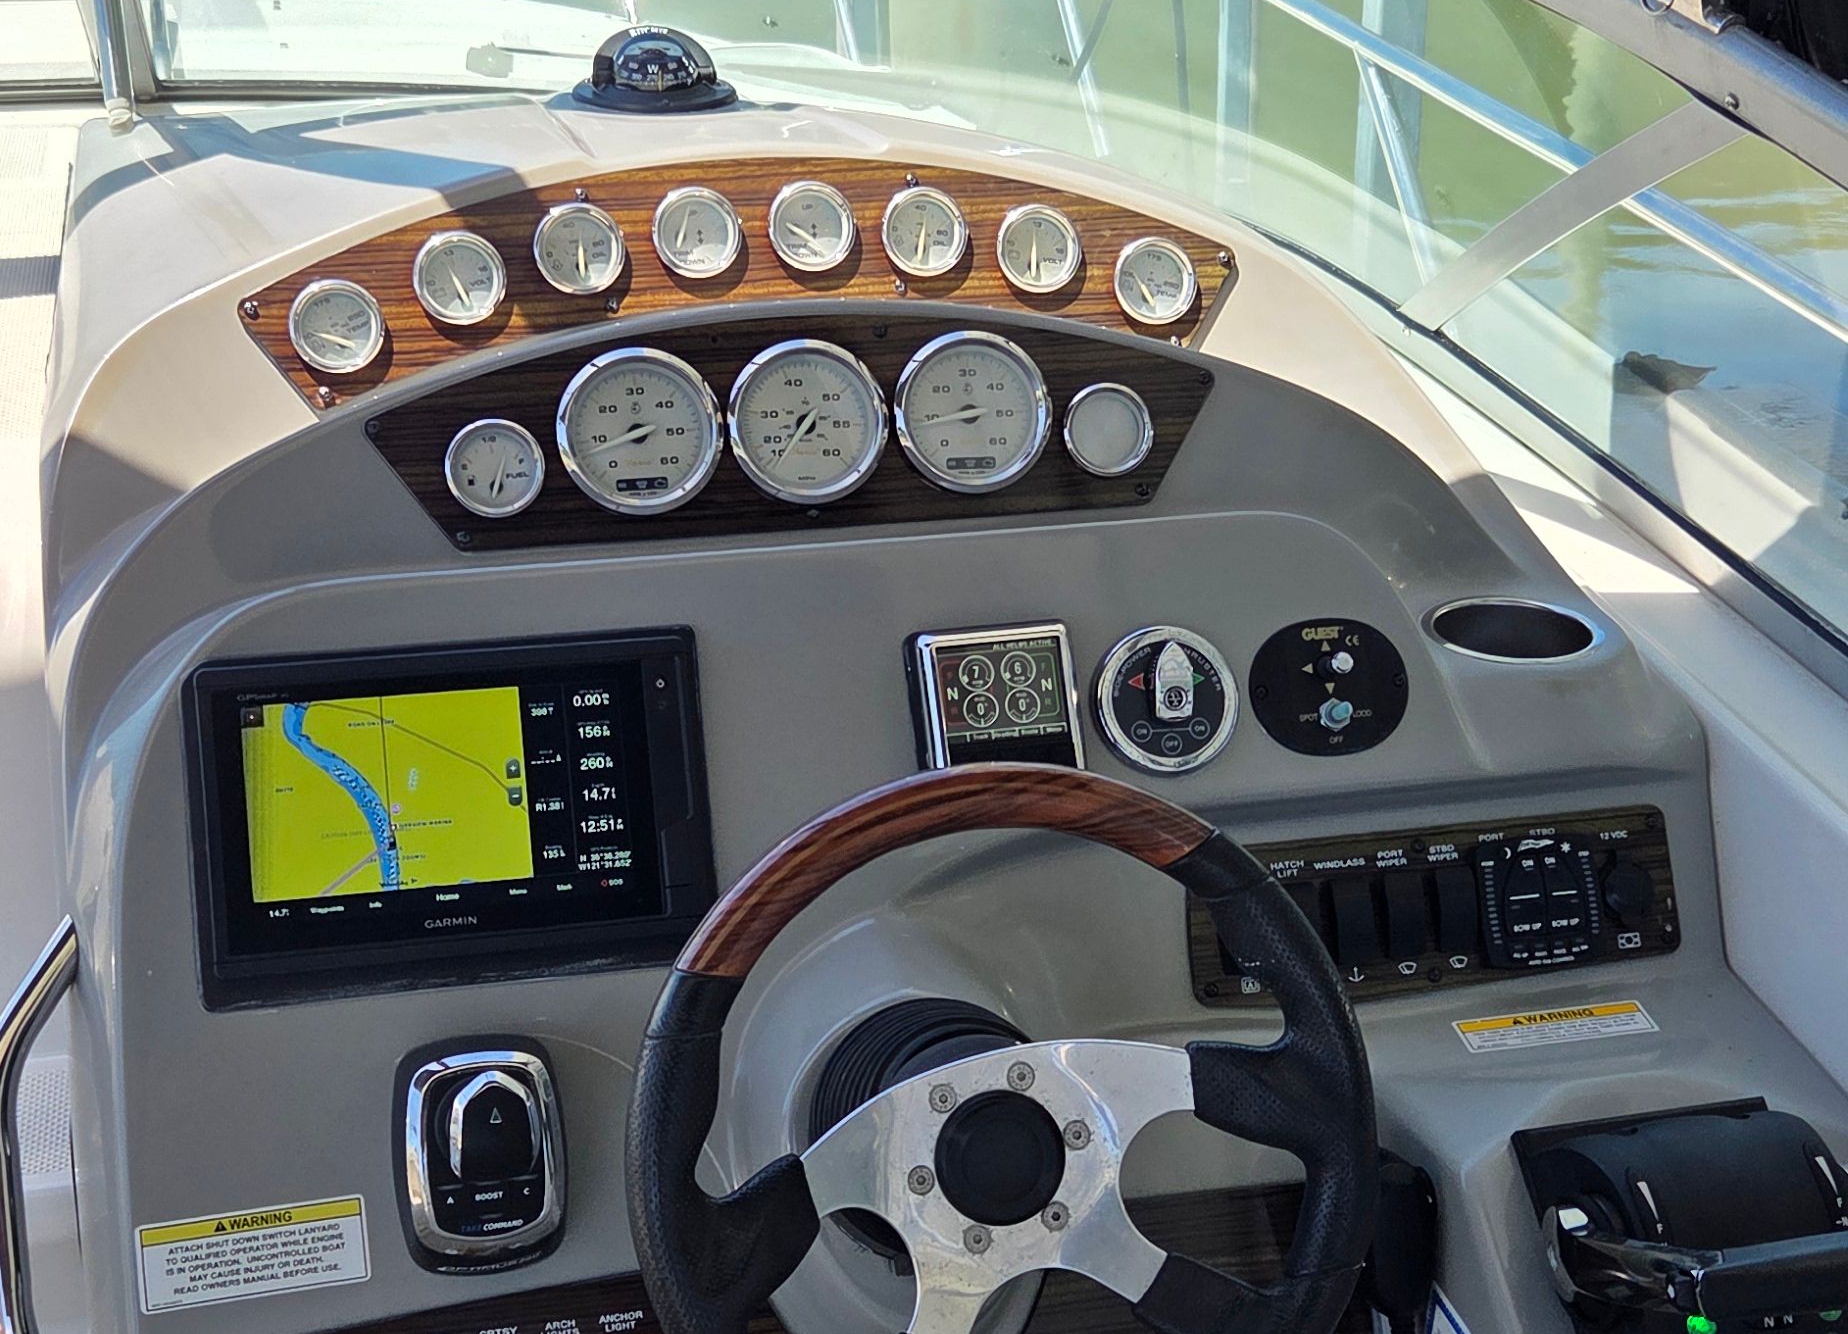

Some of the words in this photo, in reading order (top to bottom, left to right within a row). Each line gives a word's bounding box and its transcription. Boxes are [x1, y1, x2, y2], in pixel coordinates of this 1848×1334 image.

[1041, 256, 1064, 266] VOLT
[469, 276, 491, 288] VOLT
[347, 321, 371, 334] TEMP
[958, 368, 977, 377] 30
[784, 378, 803, 388] 40
[986, 382, 1005, 391] 40
[625, 387, 645, 396] 30
[932, 385, 951, 394] 20
[822, 393, 841, 402] 50
[598, 404, 618, 414] 20
[655, 400, 674, 409] 40
[760, 410, 779, 419] 30
[996, 409, 1014, 418] 50
[832, 420, 851, 429] 55
[666, 427, 685, 436] 50
[591, 434, 608, 443] 10
[763, 435, 782, 444] 20
[940, 439, 949, 447] 0
[989, 437, 1007, 446] 60
[822, 448, 841, 457] 60
[608, 460, 618, 469] 0
[660, 456, 679, 465] 60
[506, 471, 529, 479] FUEL
[1301, 626, 1340, 641] GUEST
[972, 666, 979, 678] 7
[1014, 662, 1022, 673] 6
[1041, 678, 1053, 692] N
[947, 687, 959, 701] N
[573, 694, 601, 707] 0.00
[578, 726, 601, 739] 156
[1193, 725, 1206, 733] ON
[1165, 740, 1178, 748] OFF
[1329, 736, 1344, 744] OFF
[580, 757, 605, 770] 260
[582, 788, 610, 801] 14.7
[580, 819, 614, 833] 12:51
[1478, 833, 1504, 842] PORT
[1611, 830, 1628, 839] VDC
[1377, 849, 1403, 859] PORT
[1429, 844, 1454, 854] STBD
[1376, 857, 1407, 867] WIPER
[1427, 852, 1458, 862] WIPER
[1270, 860, 1304, 871] HATCH
[1314, 857, 1366, 870] WINDLASS
[1277, 869, 1298, 879] LIFT
[424, 916, 477, 928] GARMIN
[1524, 1008, 1594, 1024] WARNING
[447, 1196, 454, 1204] A
[475, 1191, 503, 1201] BOOST
[523, 1187, 530, 1195] C
[229, 1211, 292, 1230] WARNING
[483, 1219, 523, 1231] COMMAND
[1656, 1223, 1664, 1235] F
[168, 1243, 203, 1255] ATTACH
[206, 1239, 229, 1249] SHUT
[232, 1235, 260, 1245] DOWN
[262, 1230, 296, 1241] SWITCH
[299, 1223, 340, 1235] LANYARD
[166, 1258, 178, 1266] TO
[180, 1250, 227, 1264] QUALIFIED
[230, 1242, 278, 1255] OPERATOR
[281, 1238, 308, 1248] WHILE
[311, 1233, 344, 1244] ENGINE
[166, 1268, 174, 1276] IS
[177, 1266, 186, 1274] IN
[188, 1258, 241, 1273] OPERATION.
[247, 1246, 319, 1263] UNCONTROLLED
[322, 1242, 346, 1252] BOAT
[190, 1273, 208, 1282] MAY
[211, 1268, 241, 1279] CAUSE
[244, 1264, 275, 1274] INJURY
[278, 1261, 290, 1269] OR
[293, 1256, 324, 1266] DEATH.
[174, 1285, 199, 1295] READ
[201, 1278, 240, 1291] OWNERS
[243, 1273, 281, 1284] MANUAL
[283, 1267, 319, 1278] BEFORE
[321, 1263, 342, 1272] USE.
[599, 1310, 643, 1324] ANCHOR
[1764, 1316, 1775, 1328] N
[1783, 1314, 1794, 1325] N
[544, 1319, 576, 1332] ARCH
[605, 1320, 636, 1333] LIGHT
